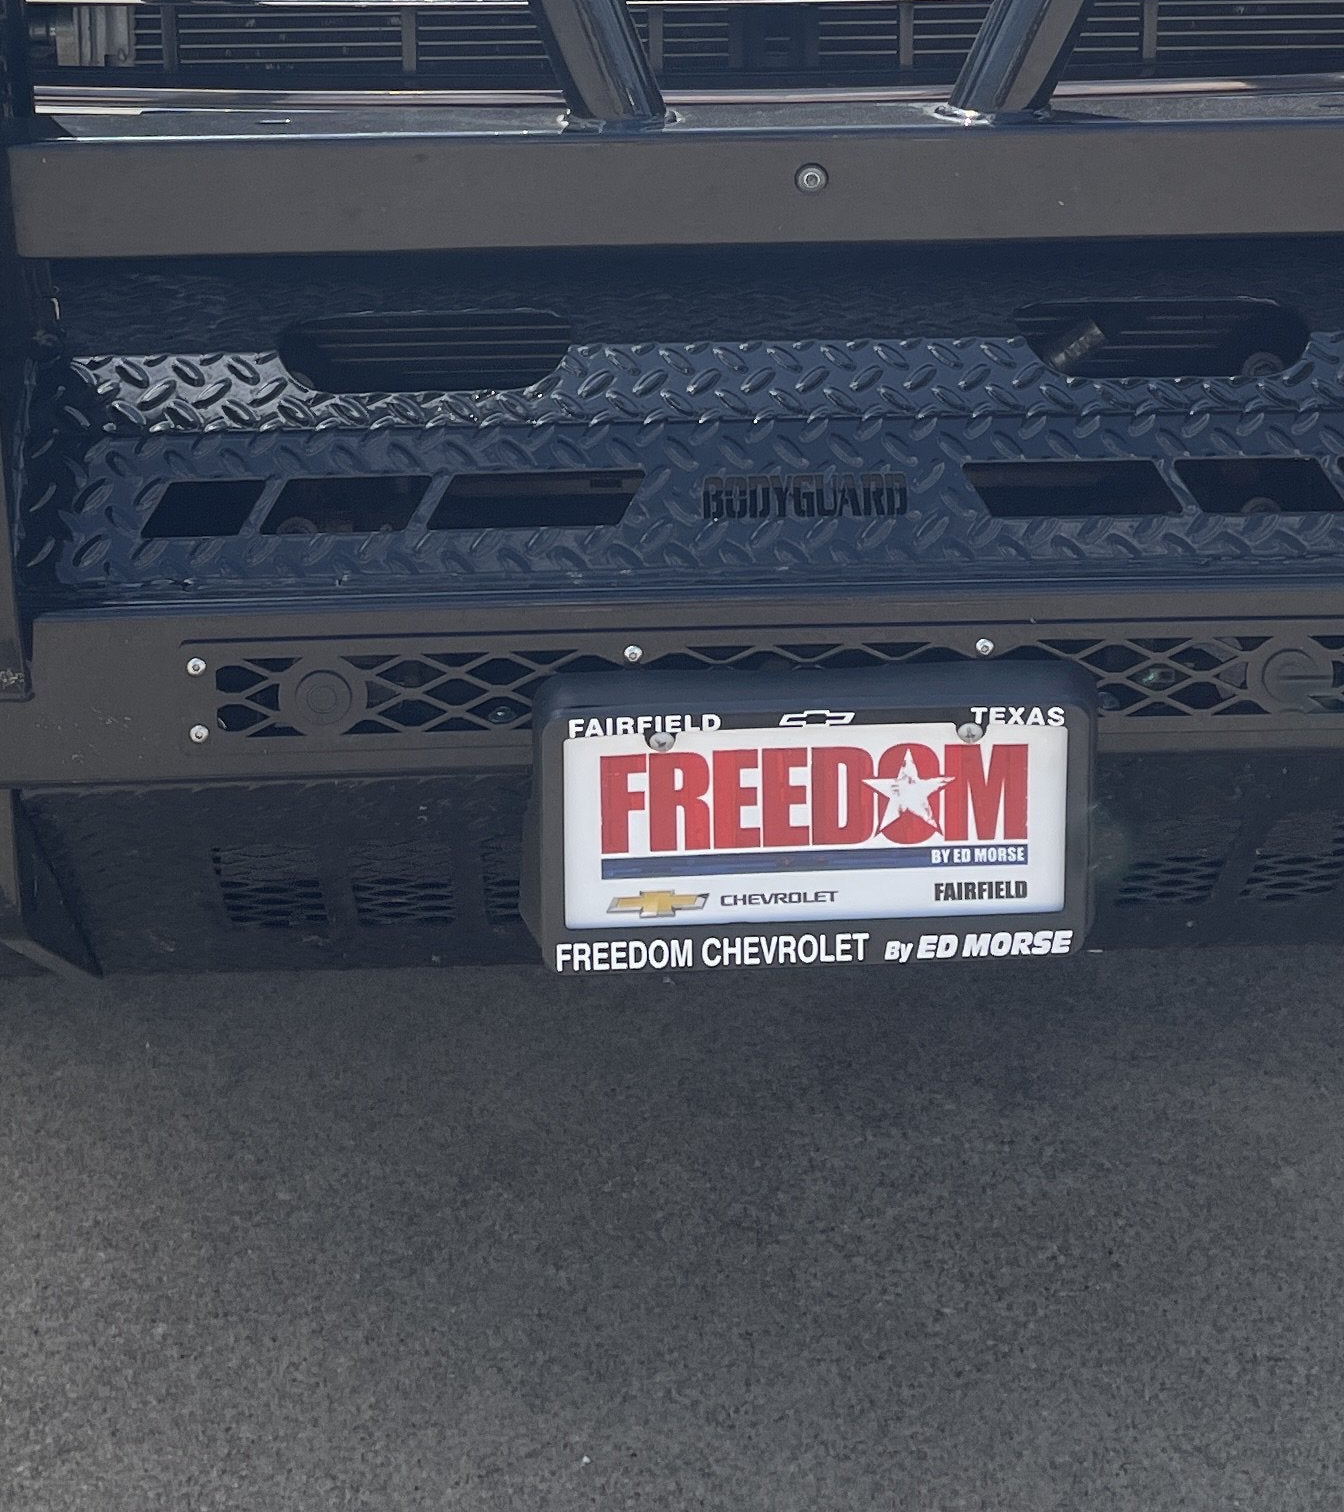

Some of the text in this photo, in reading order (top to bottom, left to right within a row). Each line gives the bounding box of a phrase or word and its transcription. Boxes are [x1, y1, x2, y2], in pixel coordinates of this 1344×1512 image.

[703, 473, 907, 519] BODYGUARD
[568, 706, 1065, 739] FAIRFIELD TEXAS
[600, 743, 1029, 854] FREEDOM
[931, 846, 1025, 864] BY ED MORSE
[720, 890, 839, 907] CHEVROLET
[934, 880, 1028, 901] FAIRFIELD
[556, 929, 1074, 973] FREEDOM CHEVROLET By ED MORSE
